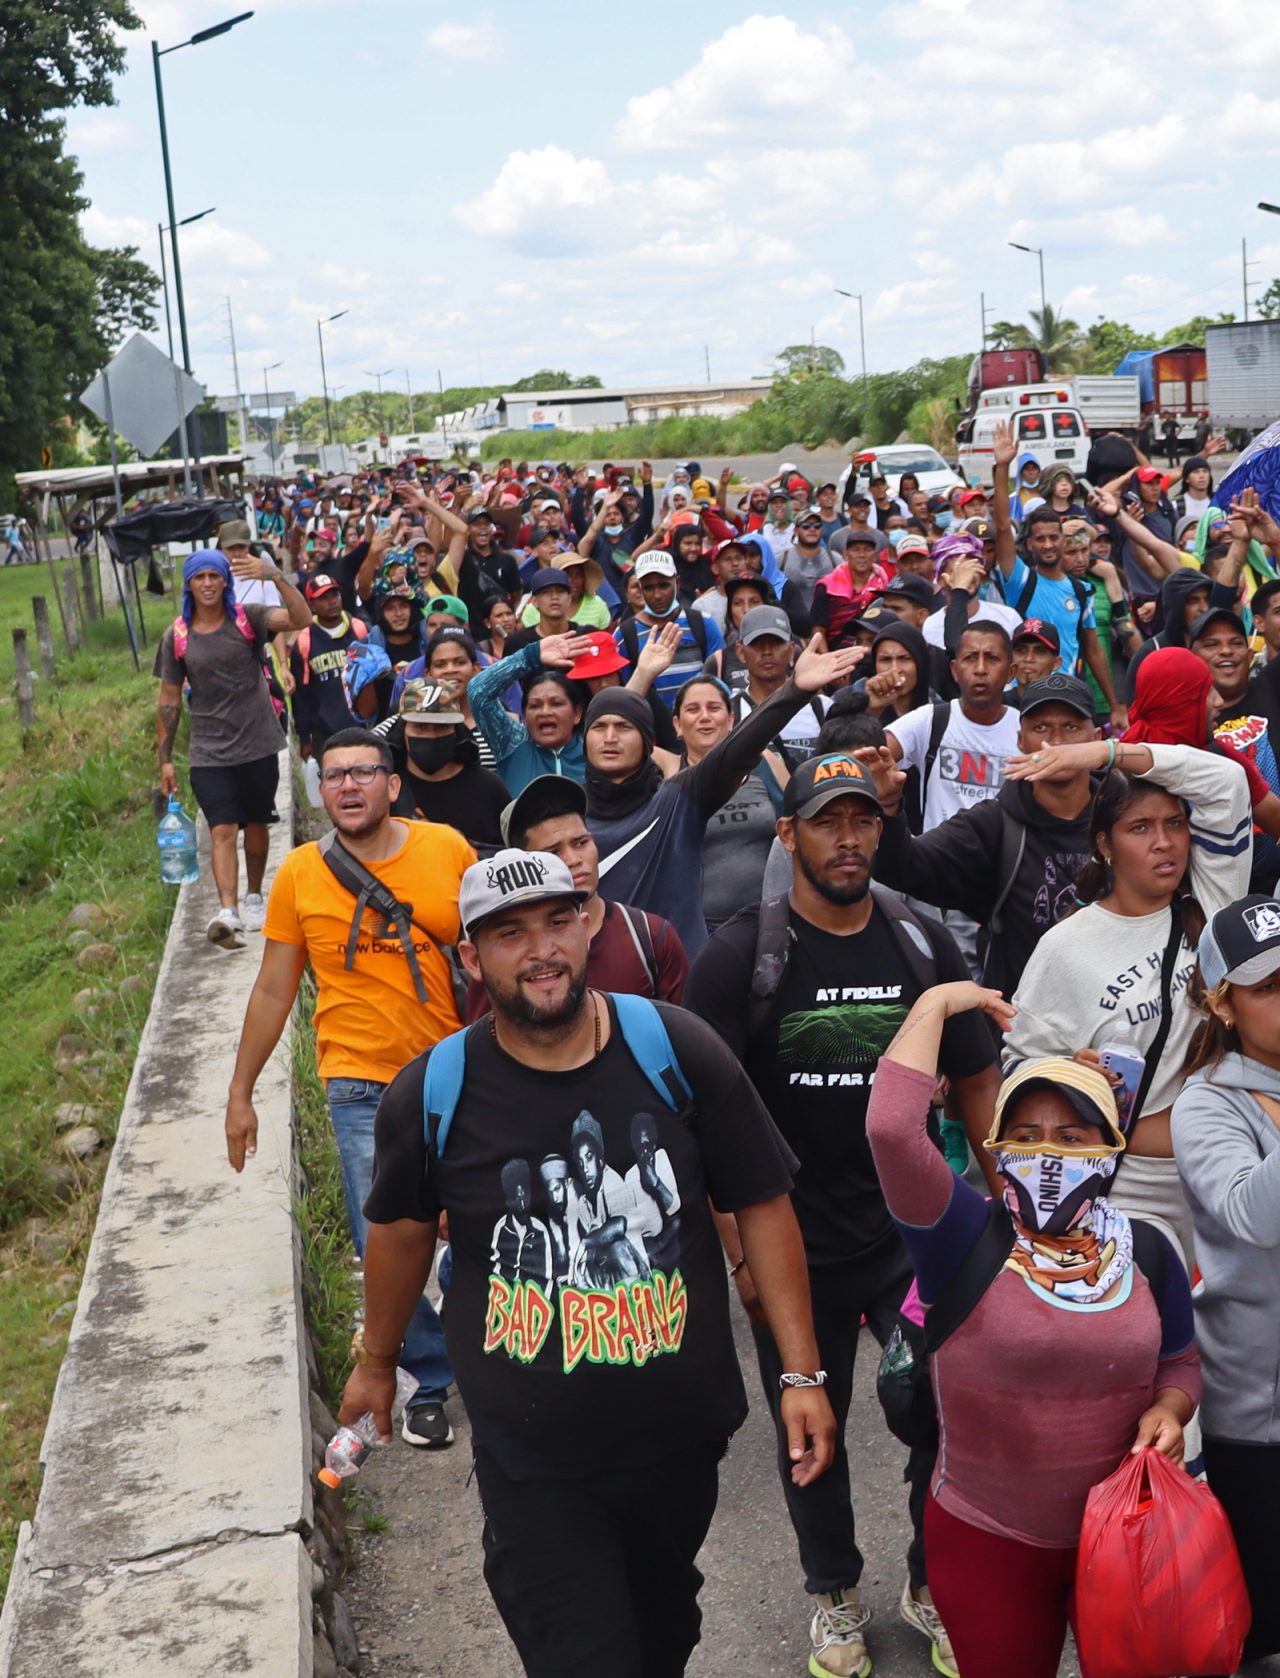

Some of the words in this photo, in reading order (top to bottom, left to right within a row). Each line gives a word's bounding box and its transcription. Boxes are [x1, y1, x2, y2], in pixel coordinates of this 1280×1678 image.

[977, 523, 987, 535] P
[640, 552, 670, 565] JORDAN
[309, 649, 348, 675] MICHIG
[813, 760, 864, 784] AFM
[338, 943, 369, 955] nw
[372, 940, 431, 955] balace
[816, 988, 840, 1002] AT
[841, 985, 902, 1000] FIDELIS
[1099, 964, 1143, 1011] EAST
[789, 1072, 824, 1087] FAR
[827, 1073, 864, 1087] FAR
[484, 1273, 555, 1365] BAD
